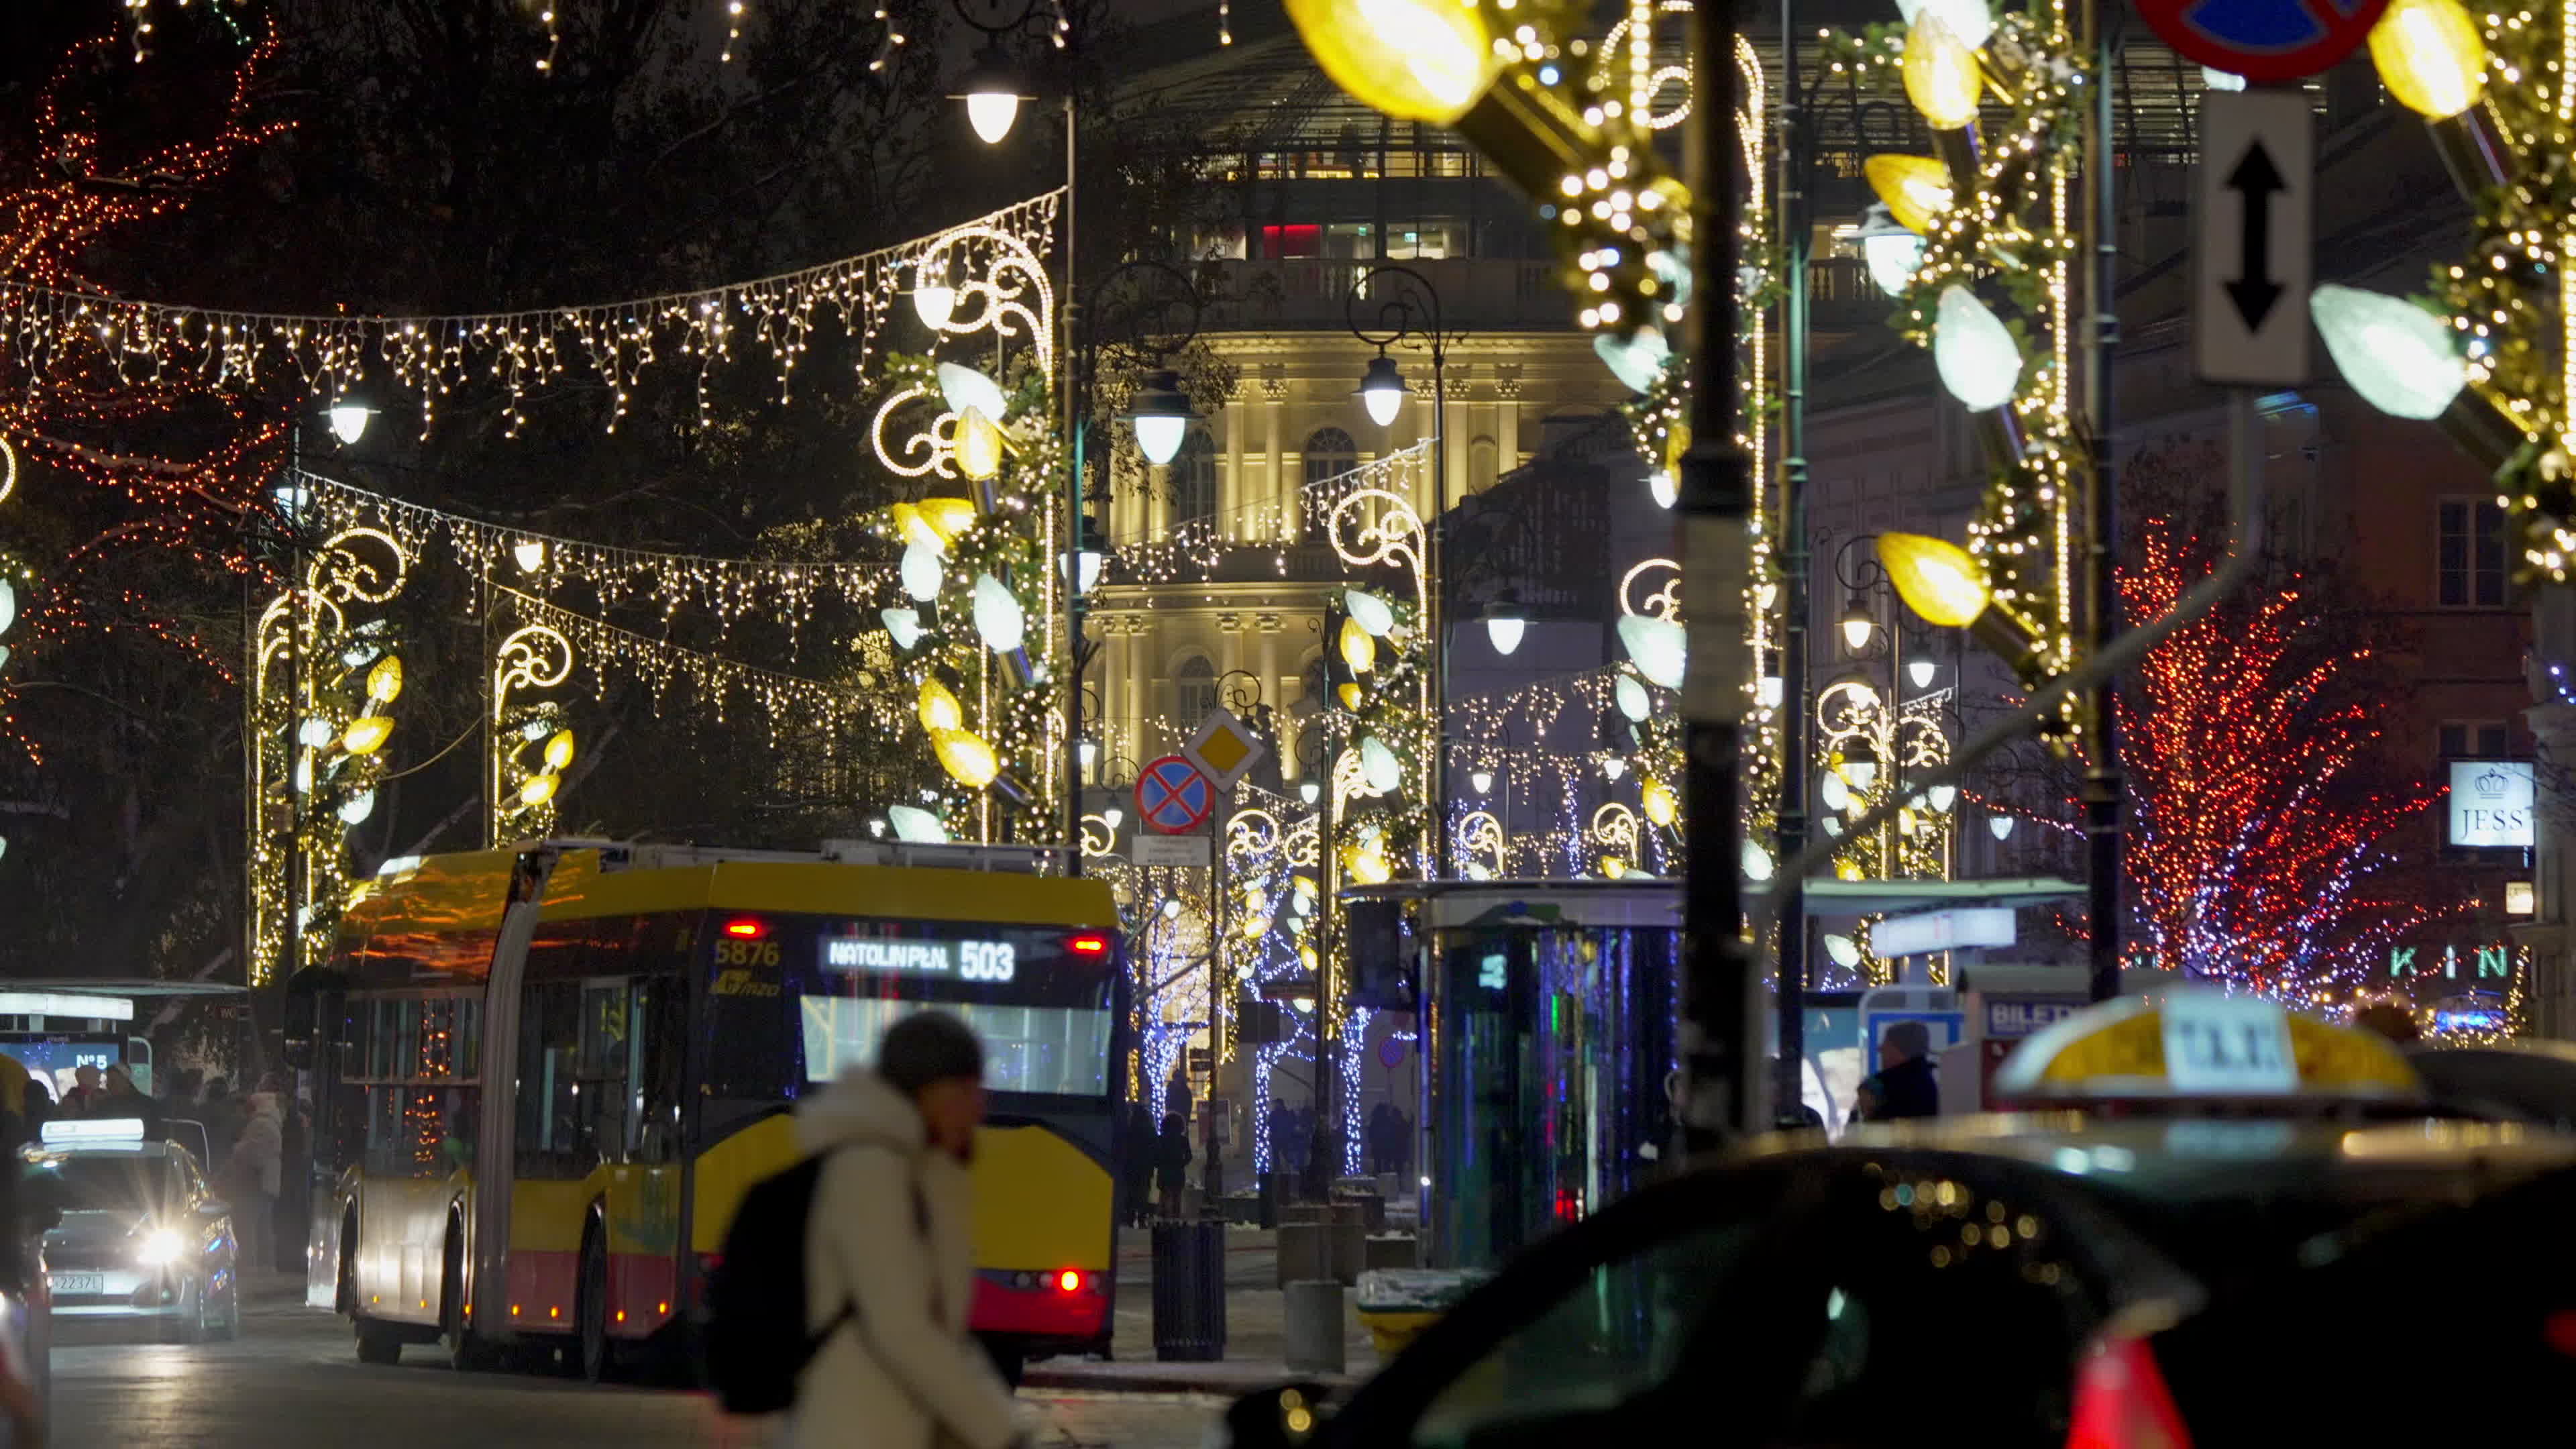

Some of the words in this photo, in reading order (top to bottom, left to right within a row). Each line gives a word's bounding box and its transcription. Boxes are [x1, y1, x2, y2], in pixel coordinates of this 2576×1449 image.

[2461, 809, 2523, 839] JESS
[714, 939, 780, 966] 5876
[829, 941, 906, 967] NATOLIN
[960, 941, 1015, 981] 503
